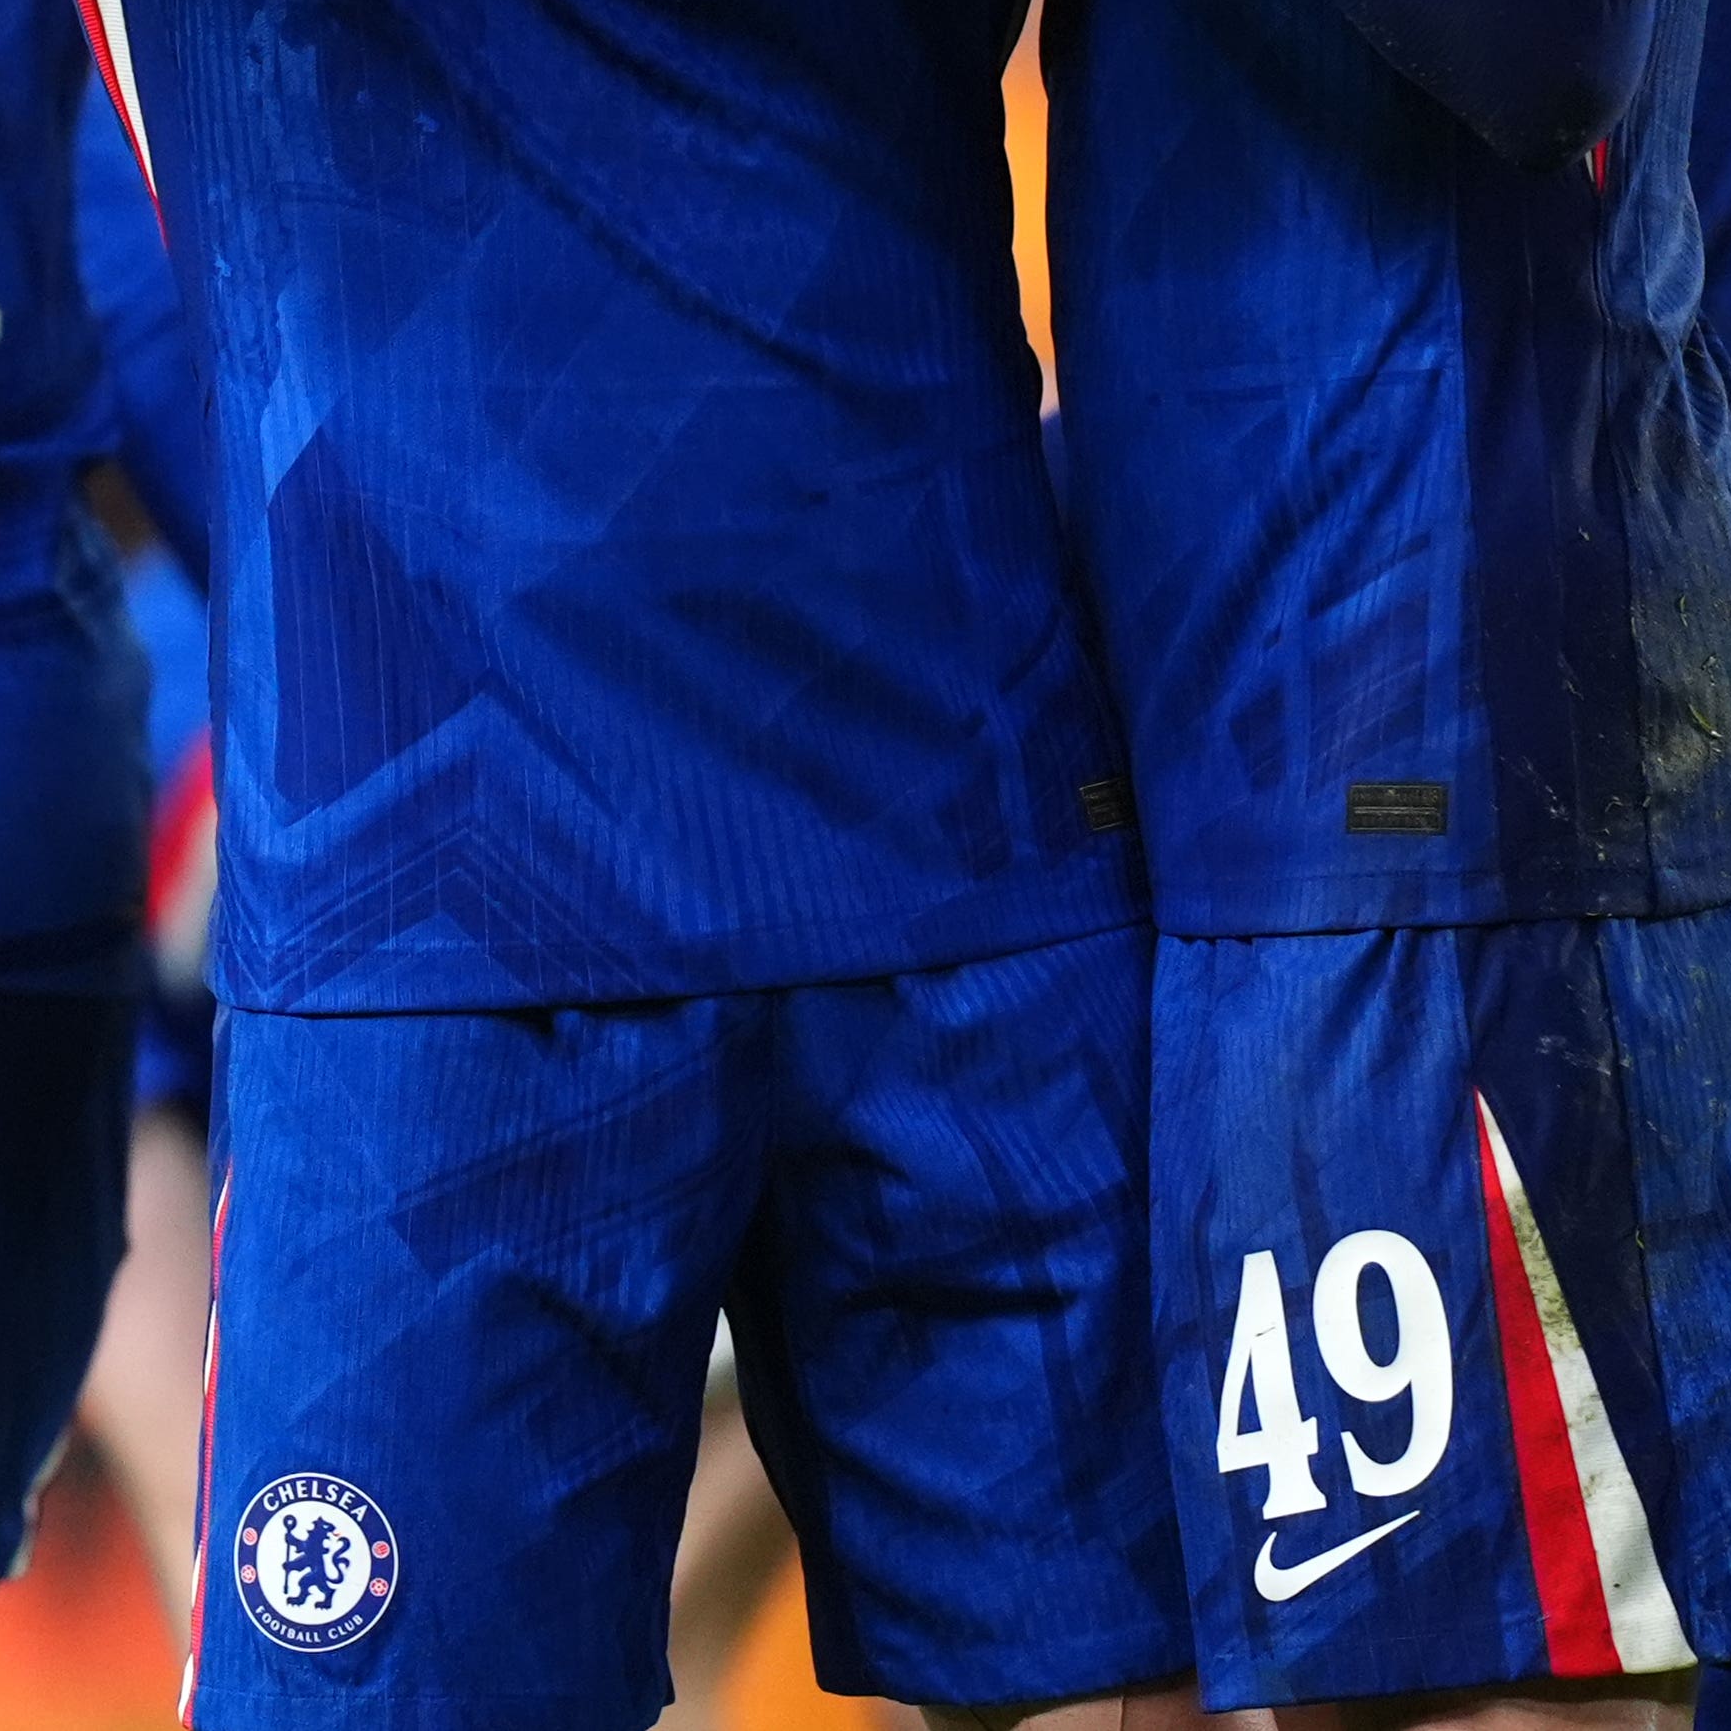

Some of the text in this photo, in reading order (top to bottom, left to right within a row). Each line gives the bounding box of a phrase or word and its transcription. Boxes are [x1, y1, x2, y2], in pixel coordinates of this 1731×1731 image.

[1216, 1229, 1453, 1520] 49
[262, 1480, 369, 1522] CHELSEA
[255, 1605, 364, 1643] FOOTBALL CLUB
